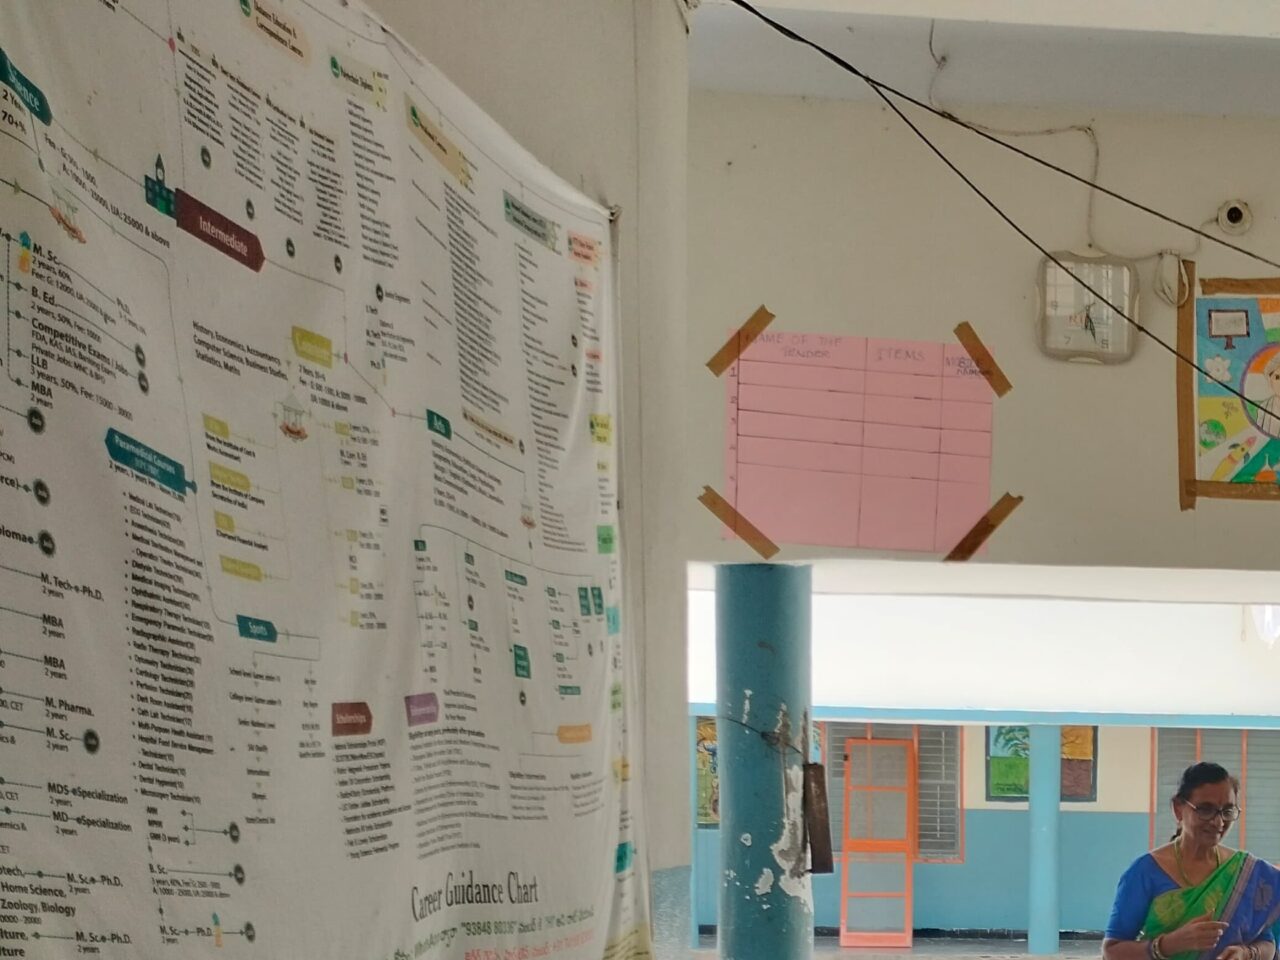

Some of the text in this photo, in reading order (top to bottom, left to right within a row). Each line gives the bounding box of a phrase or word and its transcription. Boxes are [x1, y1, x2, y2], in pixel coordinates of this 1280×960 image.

[200, 215, 248, 257] Intermediate
[31, 317, 87, 350] Competitive
[88, 344, 111, 365] Exams
[31, 354, 48, 370] LLB
[874, 346, 925, 362] ITEMS
[31, 381, 53, 399] MBA
[433, 417, 446, 434] Arts
[42, 613, 64, 629] MBA
[44, 655, 66, 670] MBA
[48, 782, 69, 795] MDS
[53, 811, 69, 822] MD
[1, 882, 29, 894] Home
[411, 870, 539, 922] Career Guidance Chart
[41, 902, 76, 917] Biology
